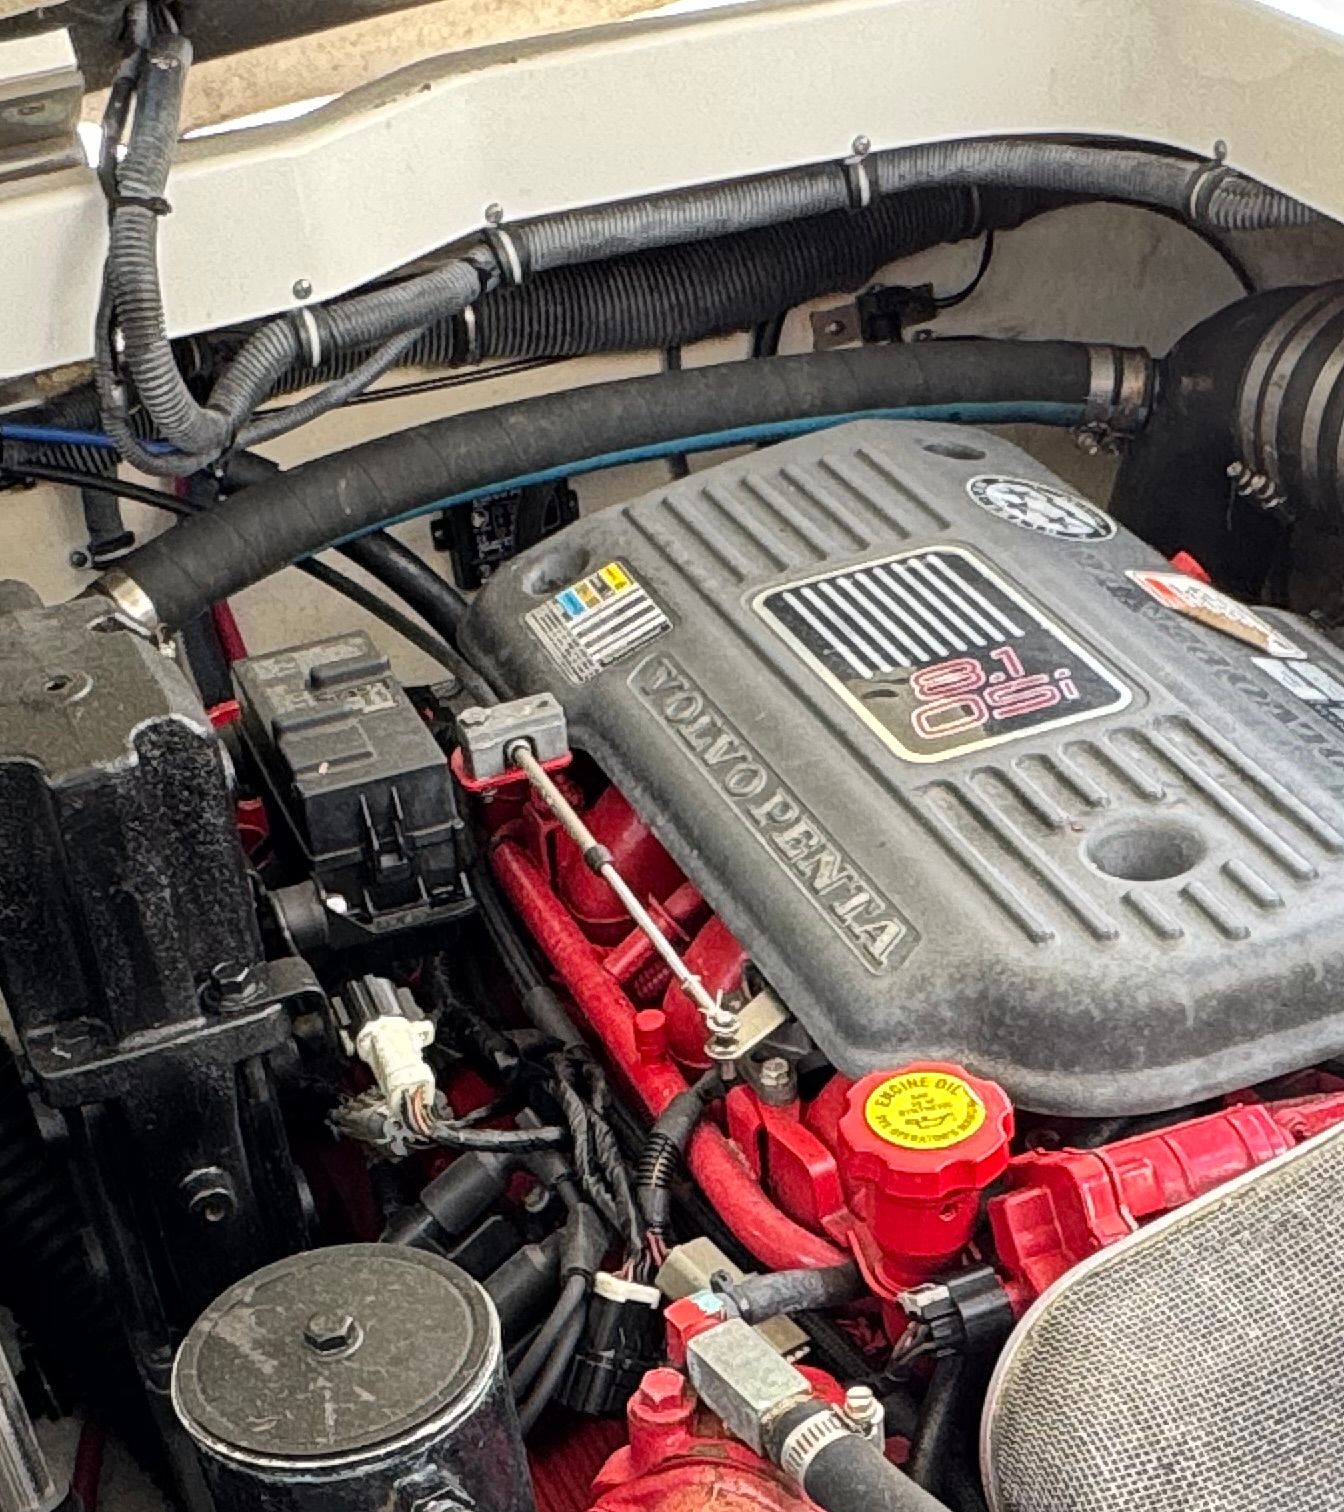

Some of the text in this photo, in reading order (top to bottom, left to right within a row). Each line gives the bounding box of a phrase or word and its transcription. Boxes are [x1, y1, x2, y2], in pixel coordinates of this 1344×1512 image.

[910, 646, 1026, 700] 8.1
[644, 662, 908, 966] VOLVO PENTA
[875, 1077, 929, 1107] ENGINE
[935, 1078, 962, 1095] OIL
